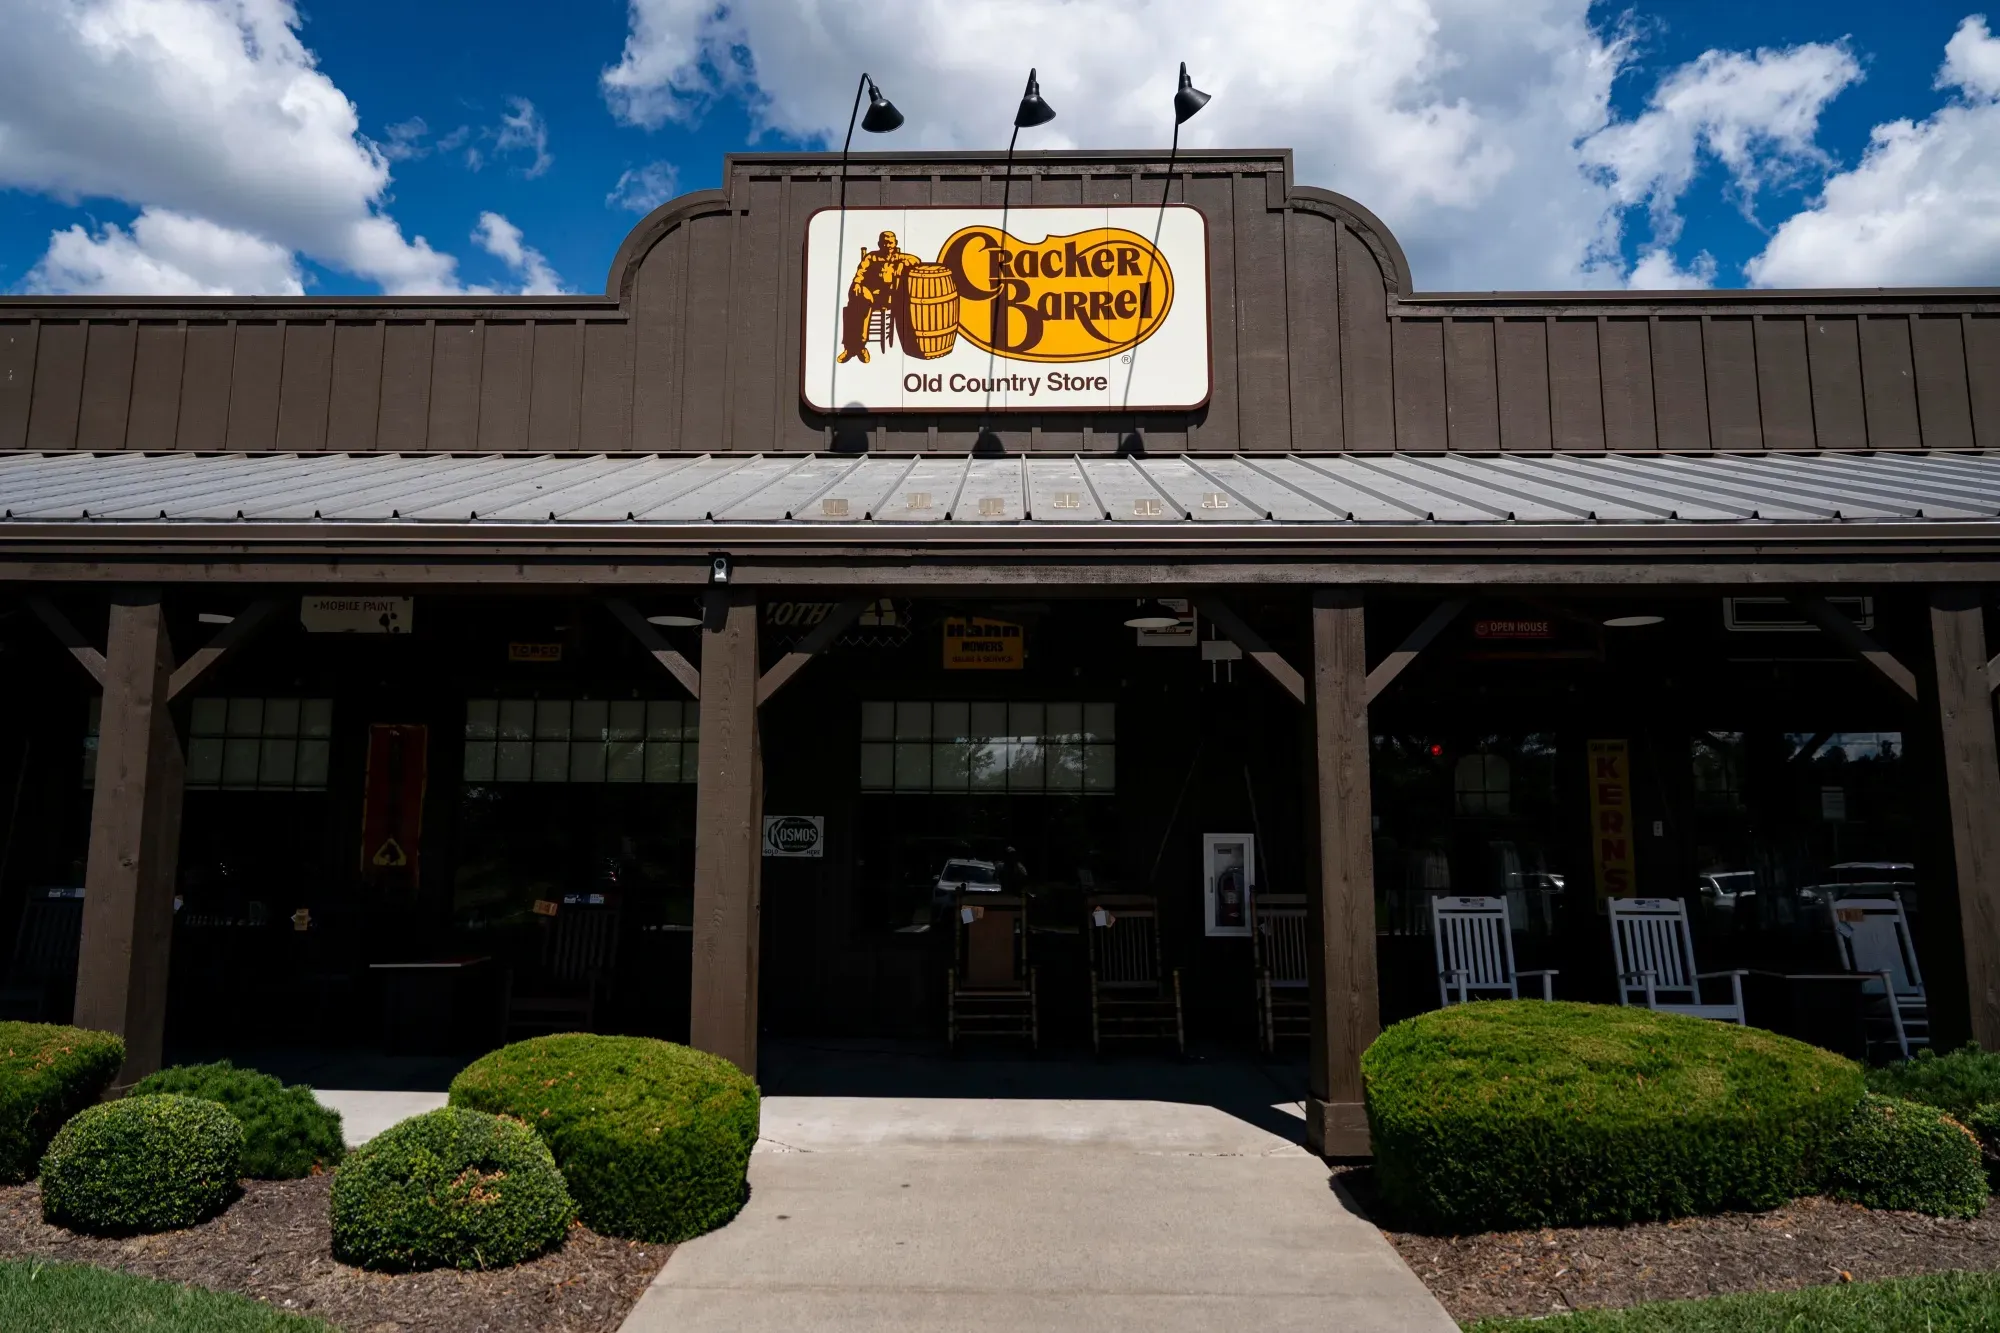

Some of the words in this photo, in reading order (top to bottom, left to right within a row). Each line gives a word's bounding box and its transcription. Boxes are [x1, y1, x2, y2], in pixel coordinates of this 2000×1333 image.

[944, 232, 1142, 300] Cracker
[991, 278, 1153, 353] Barrel
[904, 374, 942, 392] Old
[950, 374, 1040, 396] Country
[1048, 372, 1107, 391] Store
[320, 601, 359, 611] MOBILE
[364, 602, 394, 612] PAINT
[1490, 621, 1515, 632] OPEN
[1517, 621, 1549, 632] HOUSE
[961, 641, 1004, 652] MOWERS
